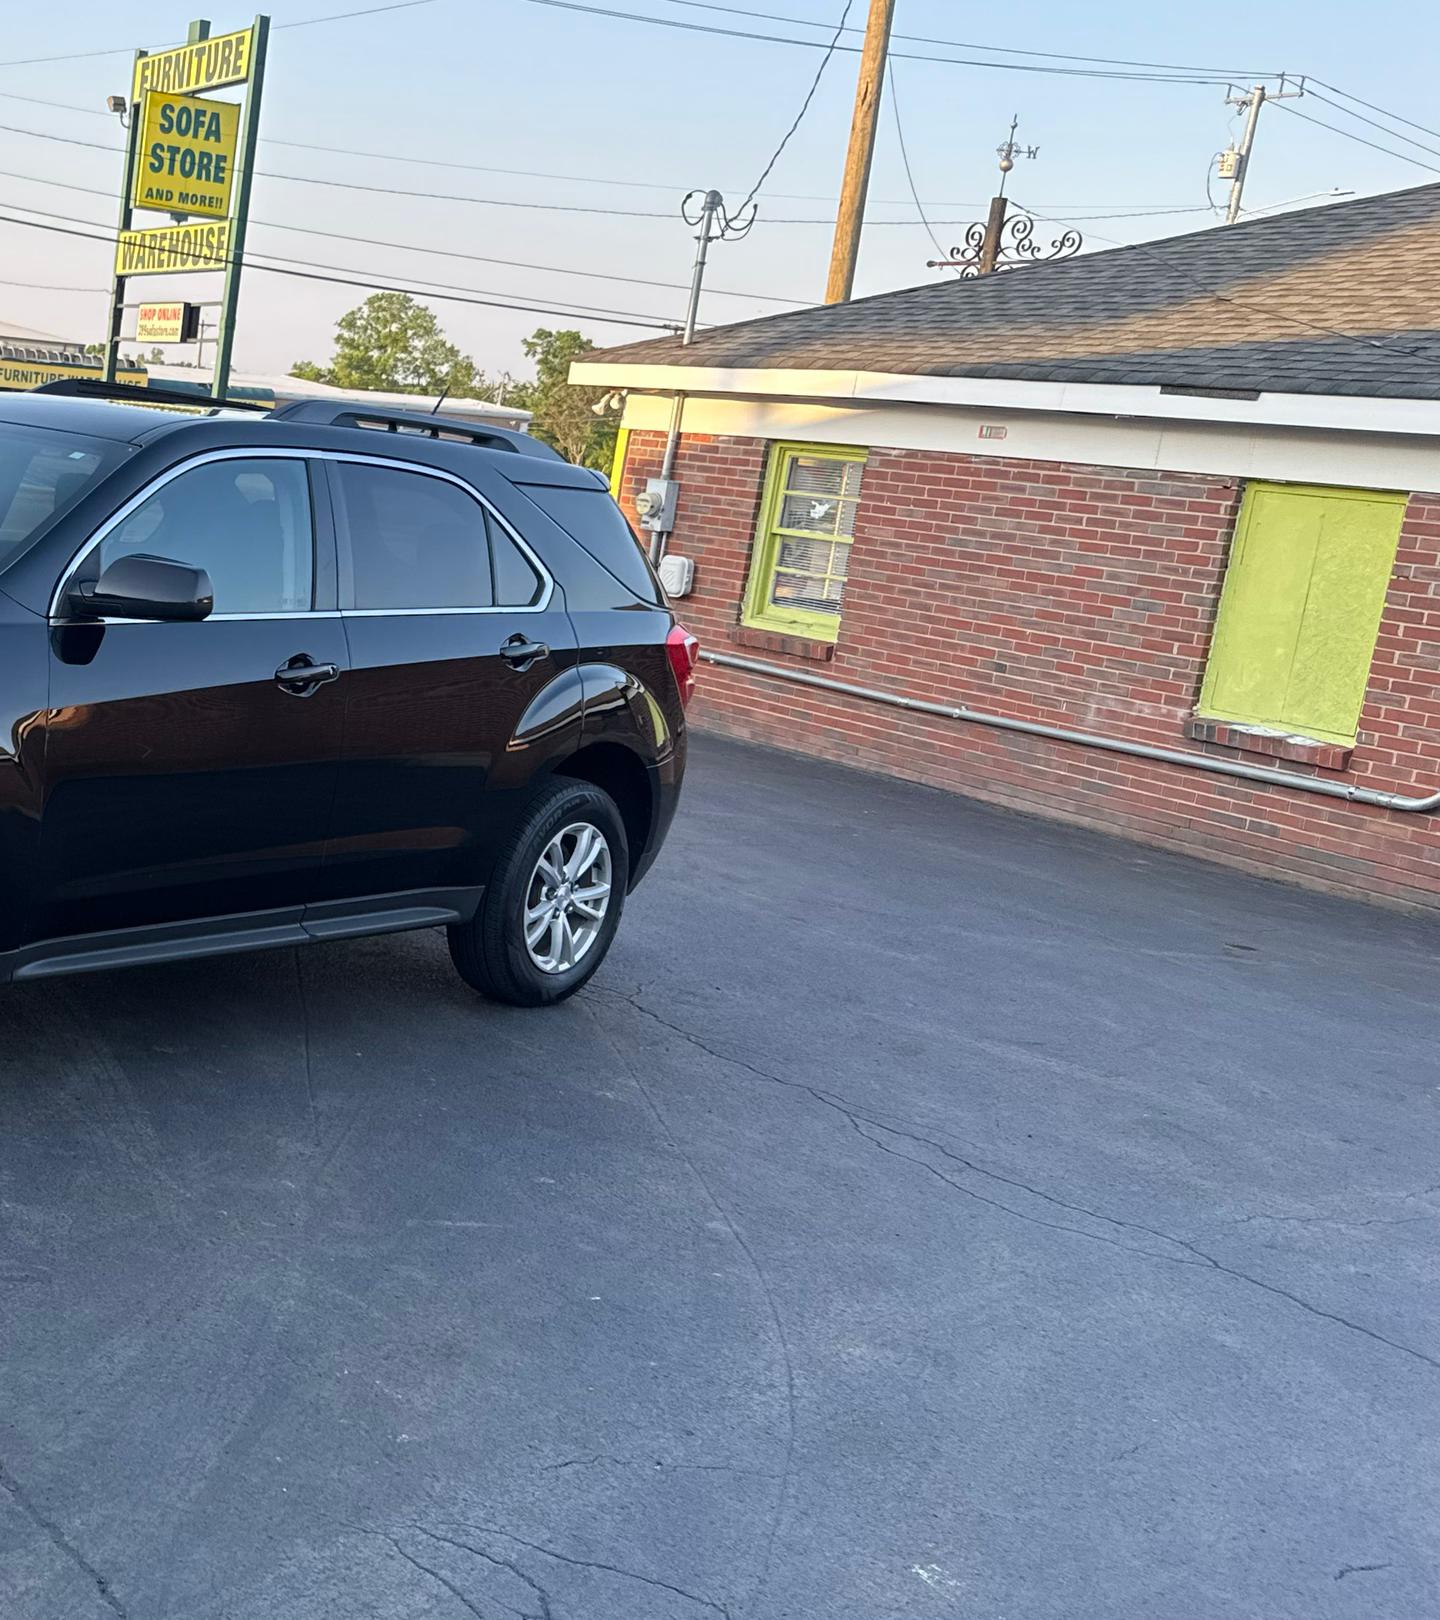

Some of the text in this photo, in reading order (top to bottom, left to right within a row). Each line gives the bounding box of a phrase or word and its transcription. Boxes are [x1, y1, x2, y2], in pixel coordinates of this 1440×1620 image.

[139, 35, 245, 98] FURNITURE
[159, 103, 222, 143] SOFA
[148, 142, 228, 185] STORE
[145, 187, 223, 210] AND MORE!!
[122, 226, 226, 270] WAREHOUSE
[140, 307, 181, 321] SHOP ONLINE
